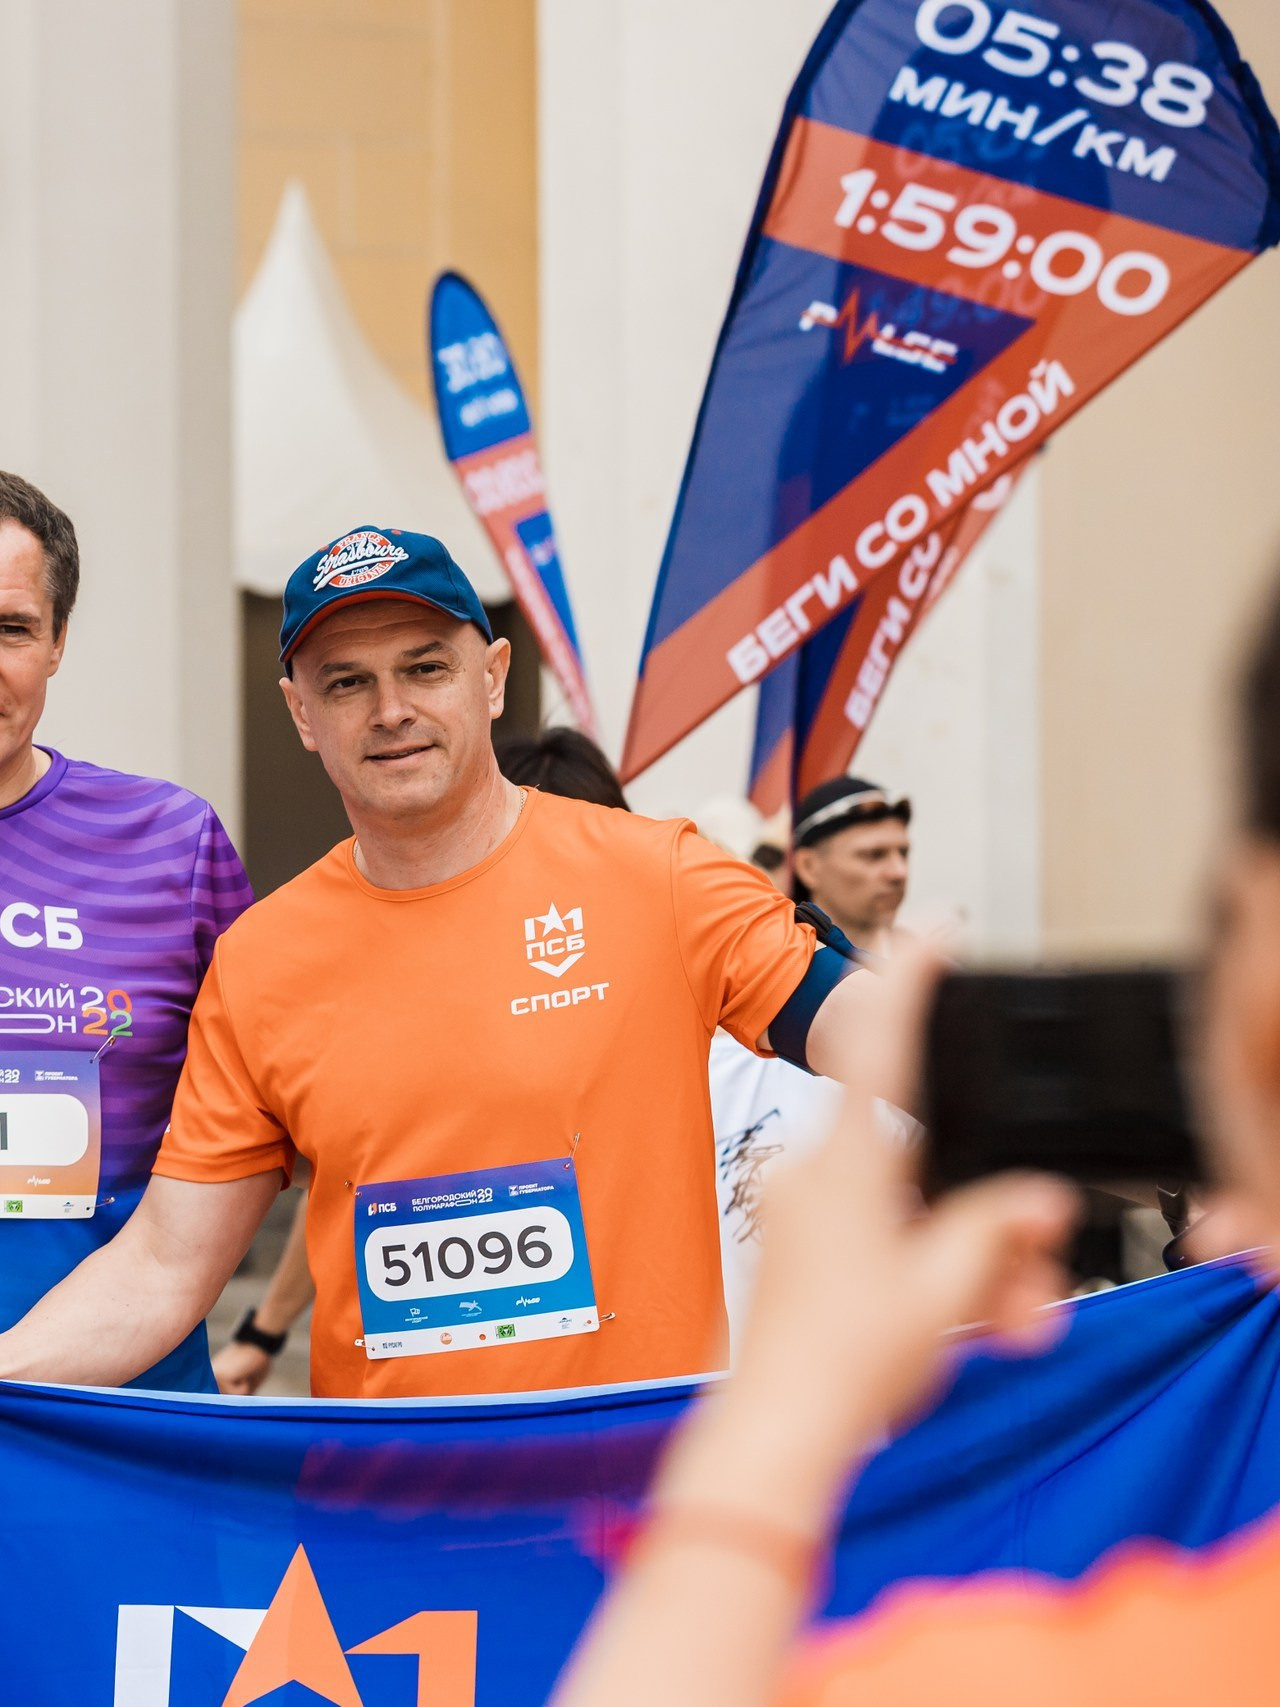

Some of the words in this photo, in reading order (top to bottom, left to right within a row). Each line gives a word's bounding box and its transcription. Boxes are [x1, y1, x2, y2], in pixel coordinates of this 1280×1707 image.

[913, 0, 1214, 129] 05:38
[888, 66, 1177, 182] МИН/КМ
[833, 169, 1170, 316] 1:59:00
[726, 555, 859, 684] БЕГИ
[854, 494, 929, 569] СО
[925, 359, 1075, 507] МНОЙ
[313, 537, 409, 584] Strasbourg
[338, 563, 389, 585] ORIGINAL
[526, 933, 585, 960] ПСБ
[511, 982, 609, 1015] СПОРТ
[379, 1203, 397, 1213] ПСБ
[411, 1190, 477, 1206] БЕЛГОРОДСКИЙ
[381, 1225, 552, 1287] 51096
